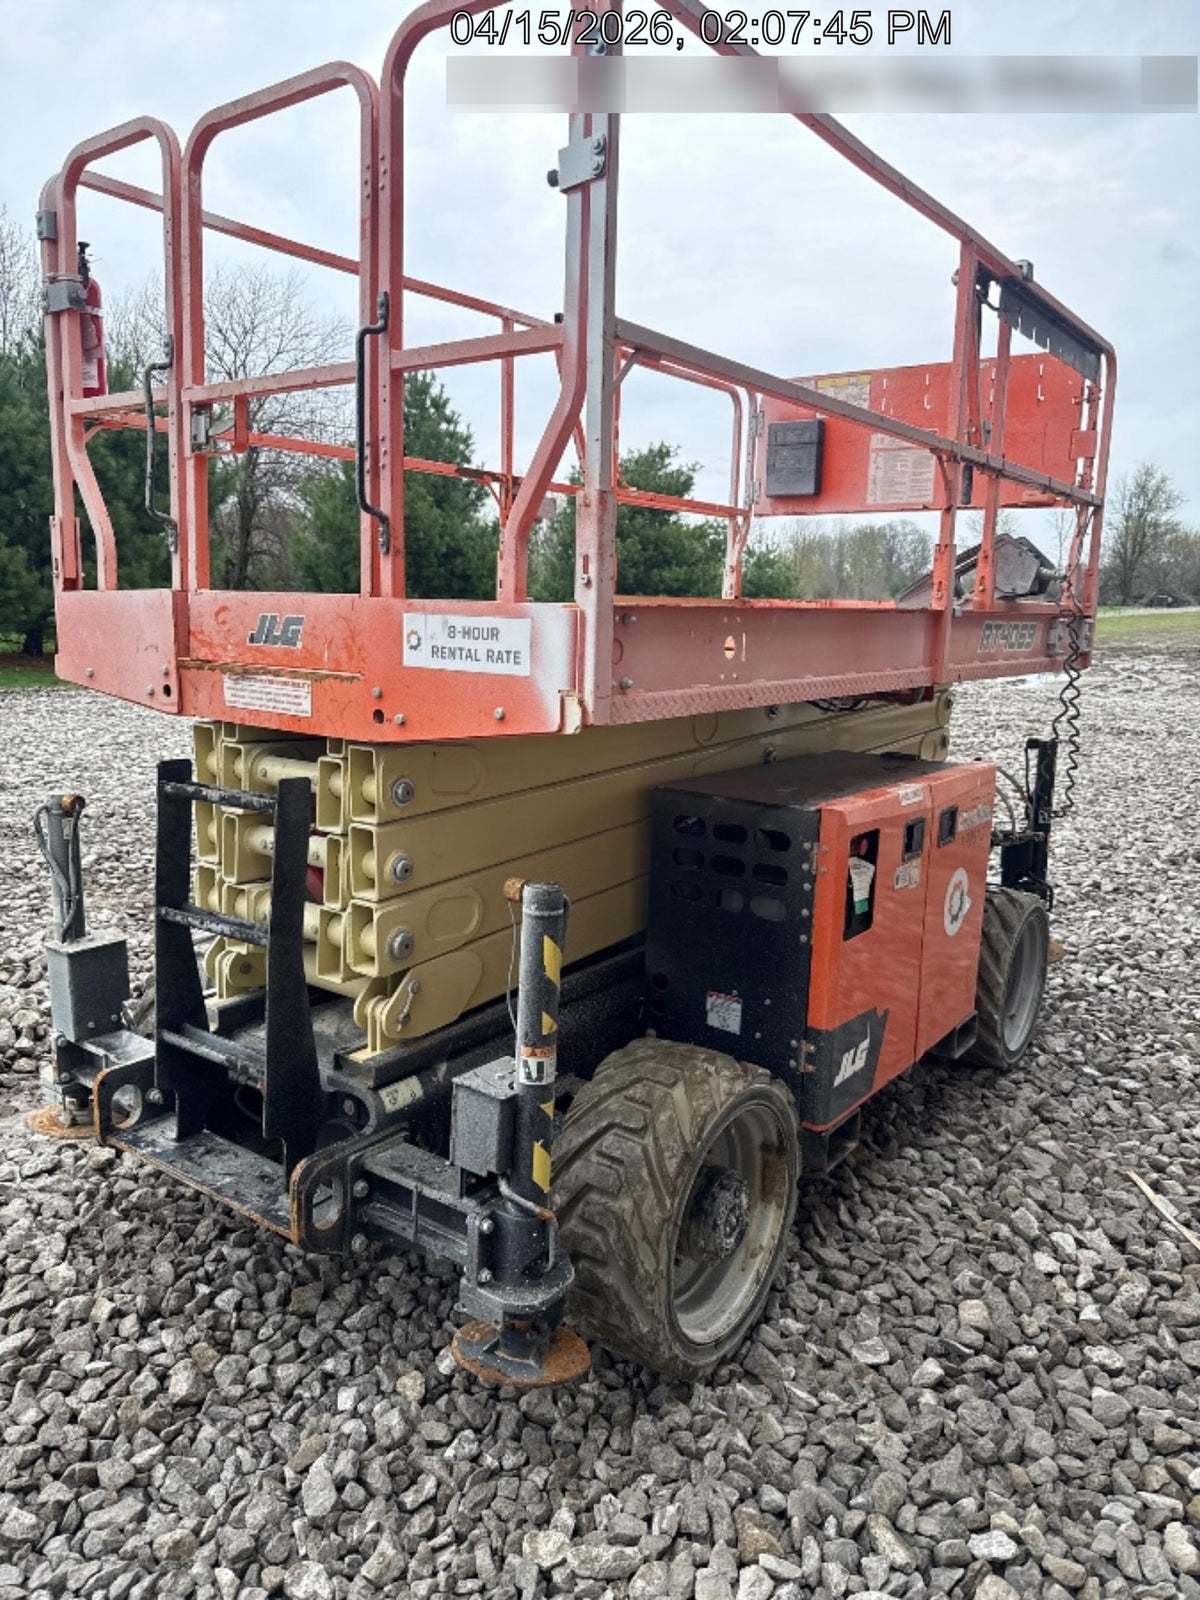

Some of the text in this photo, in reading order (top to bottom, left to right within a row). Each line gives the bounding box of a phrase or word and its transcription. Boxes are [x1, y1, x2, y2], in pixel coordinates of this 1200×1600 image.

[249, 613, 304, 647] JLG
[447, 624, 501, 643] 8-HOUR
[431, 645, 522, 666] RENTAL RATE
[832, 1036, 871, 1088] JLG
